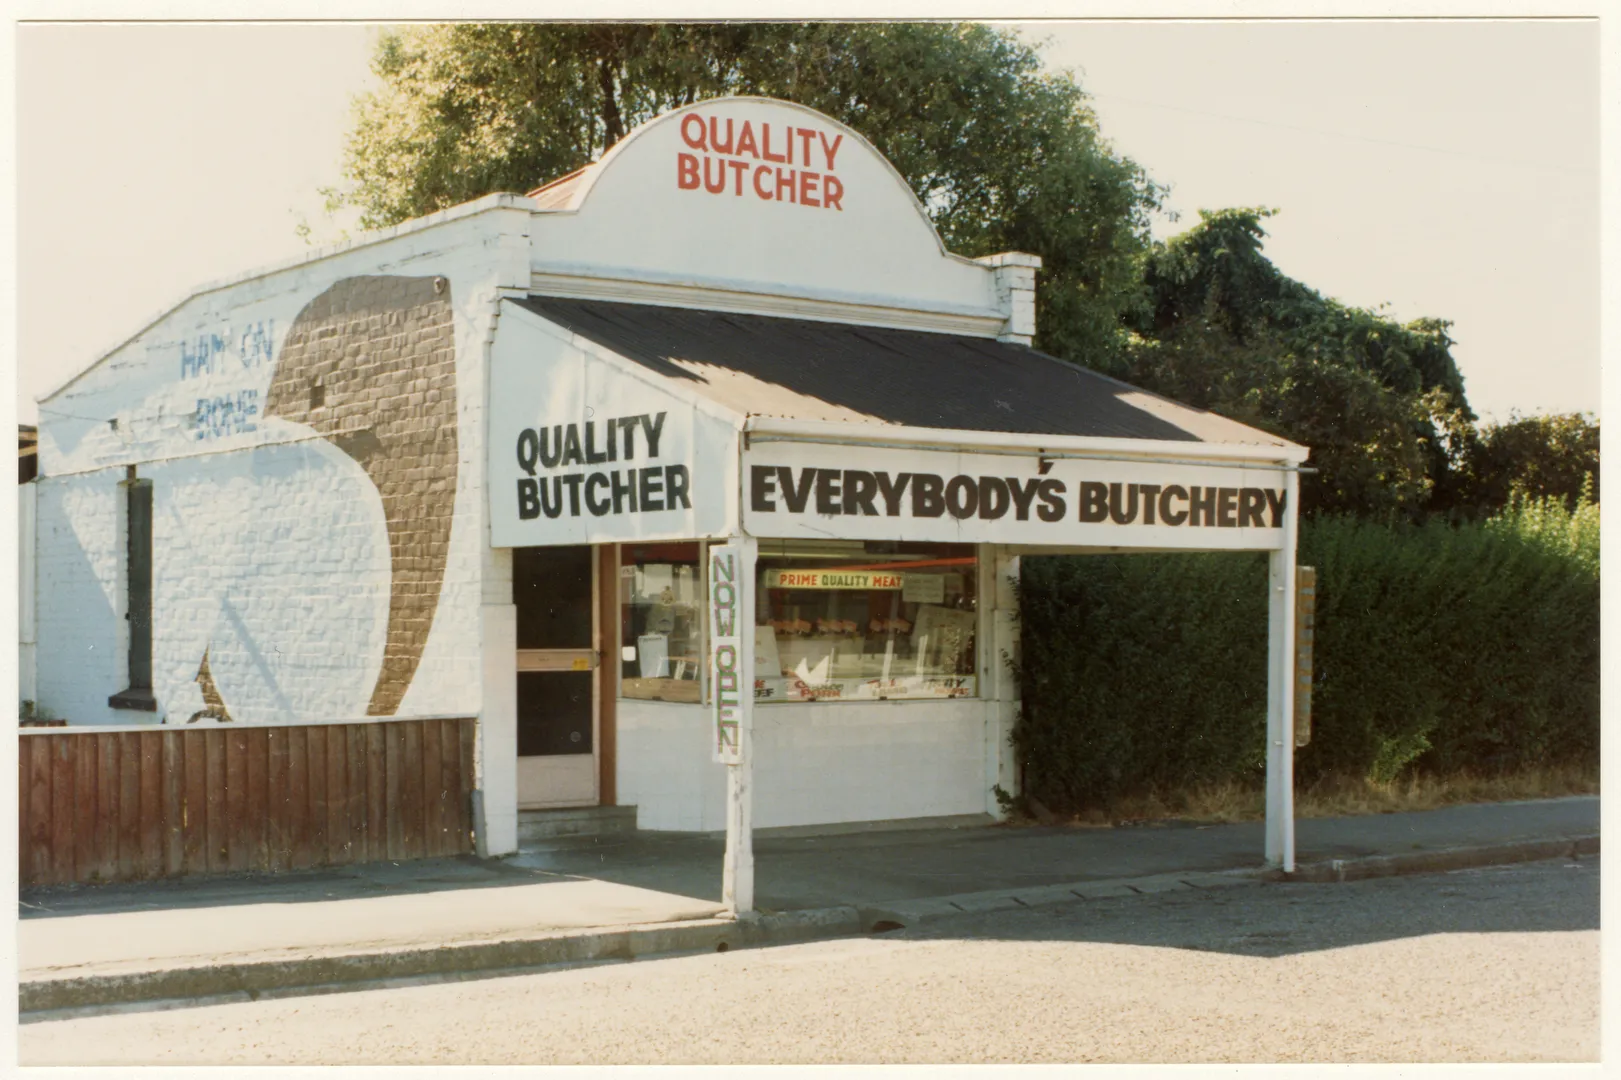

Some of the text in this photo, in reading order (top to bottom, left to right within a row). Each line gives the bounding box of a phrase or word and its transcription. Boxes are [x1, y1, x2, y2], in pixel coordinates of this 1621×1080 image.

[680, 112, 844, 171] QUALITY
[677, 152, 844, 211] BUTCHER
[516, 411, 668, 476] QUALITY
[516, 463, 693, 520] BUTCHER
[1078, 480, 1288, 528] BUTCHERY
[779, 573, 817, 587] PRIME
[821, 574, 869, 588] QUALITY
[872, 575, 903, 589] MEAT
[712, 554, 739, 756] NOW OPEN
